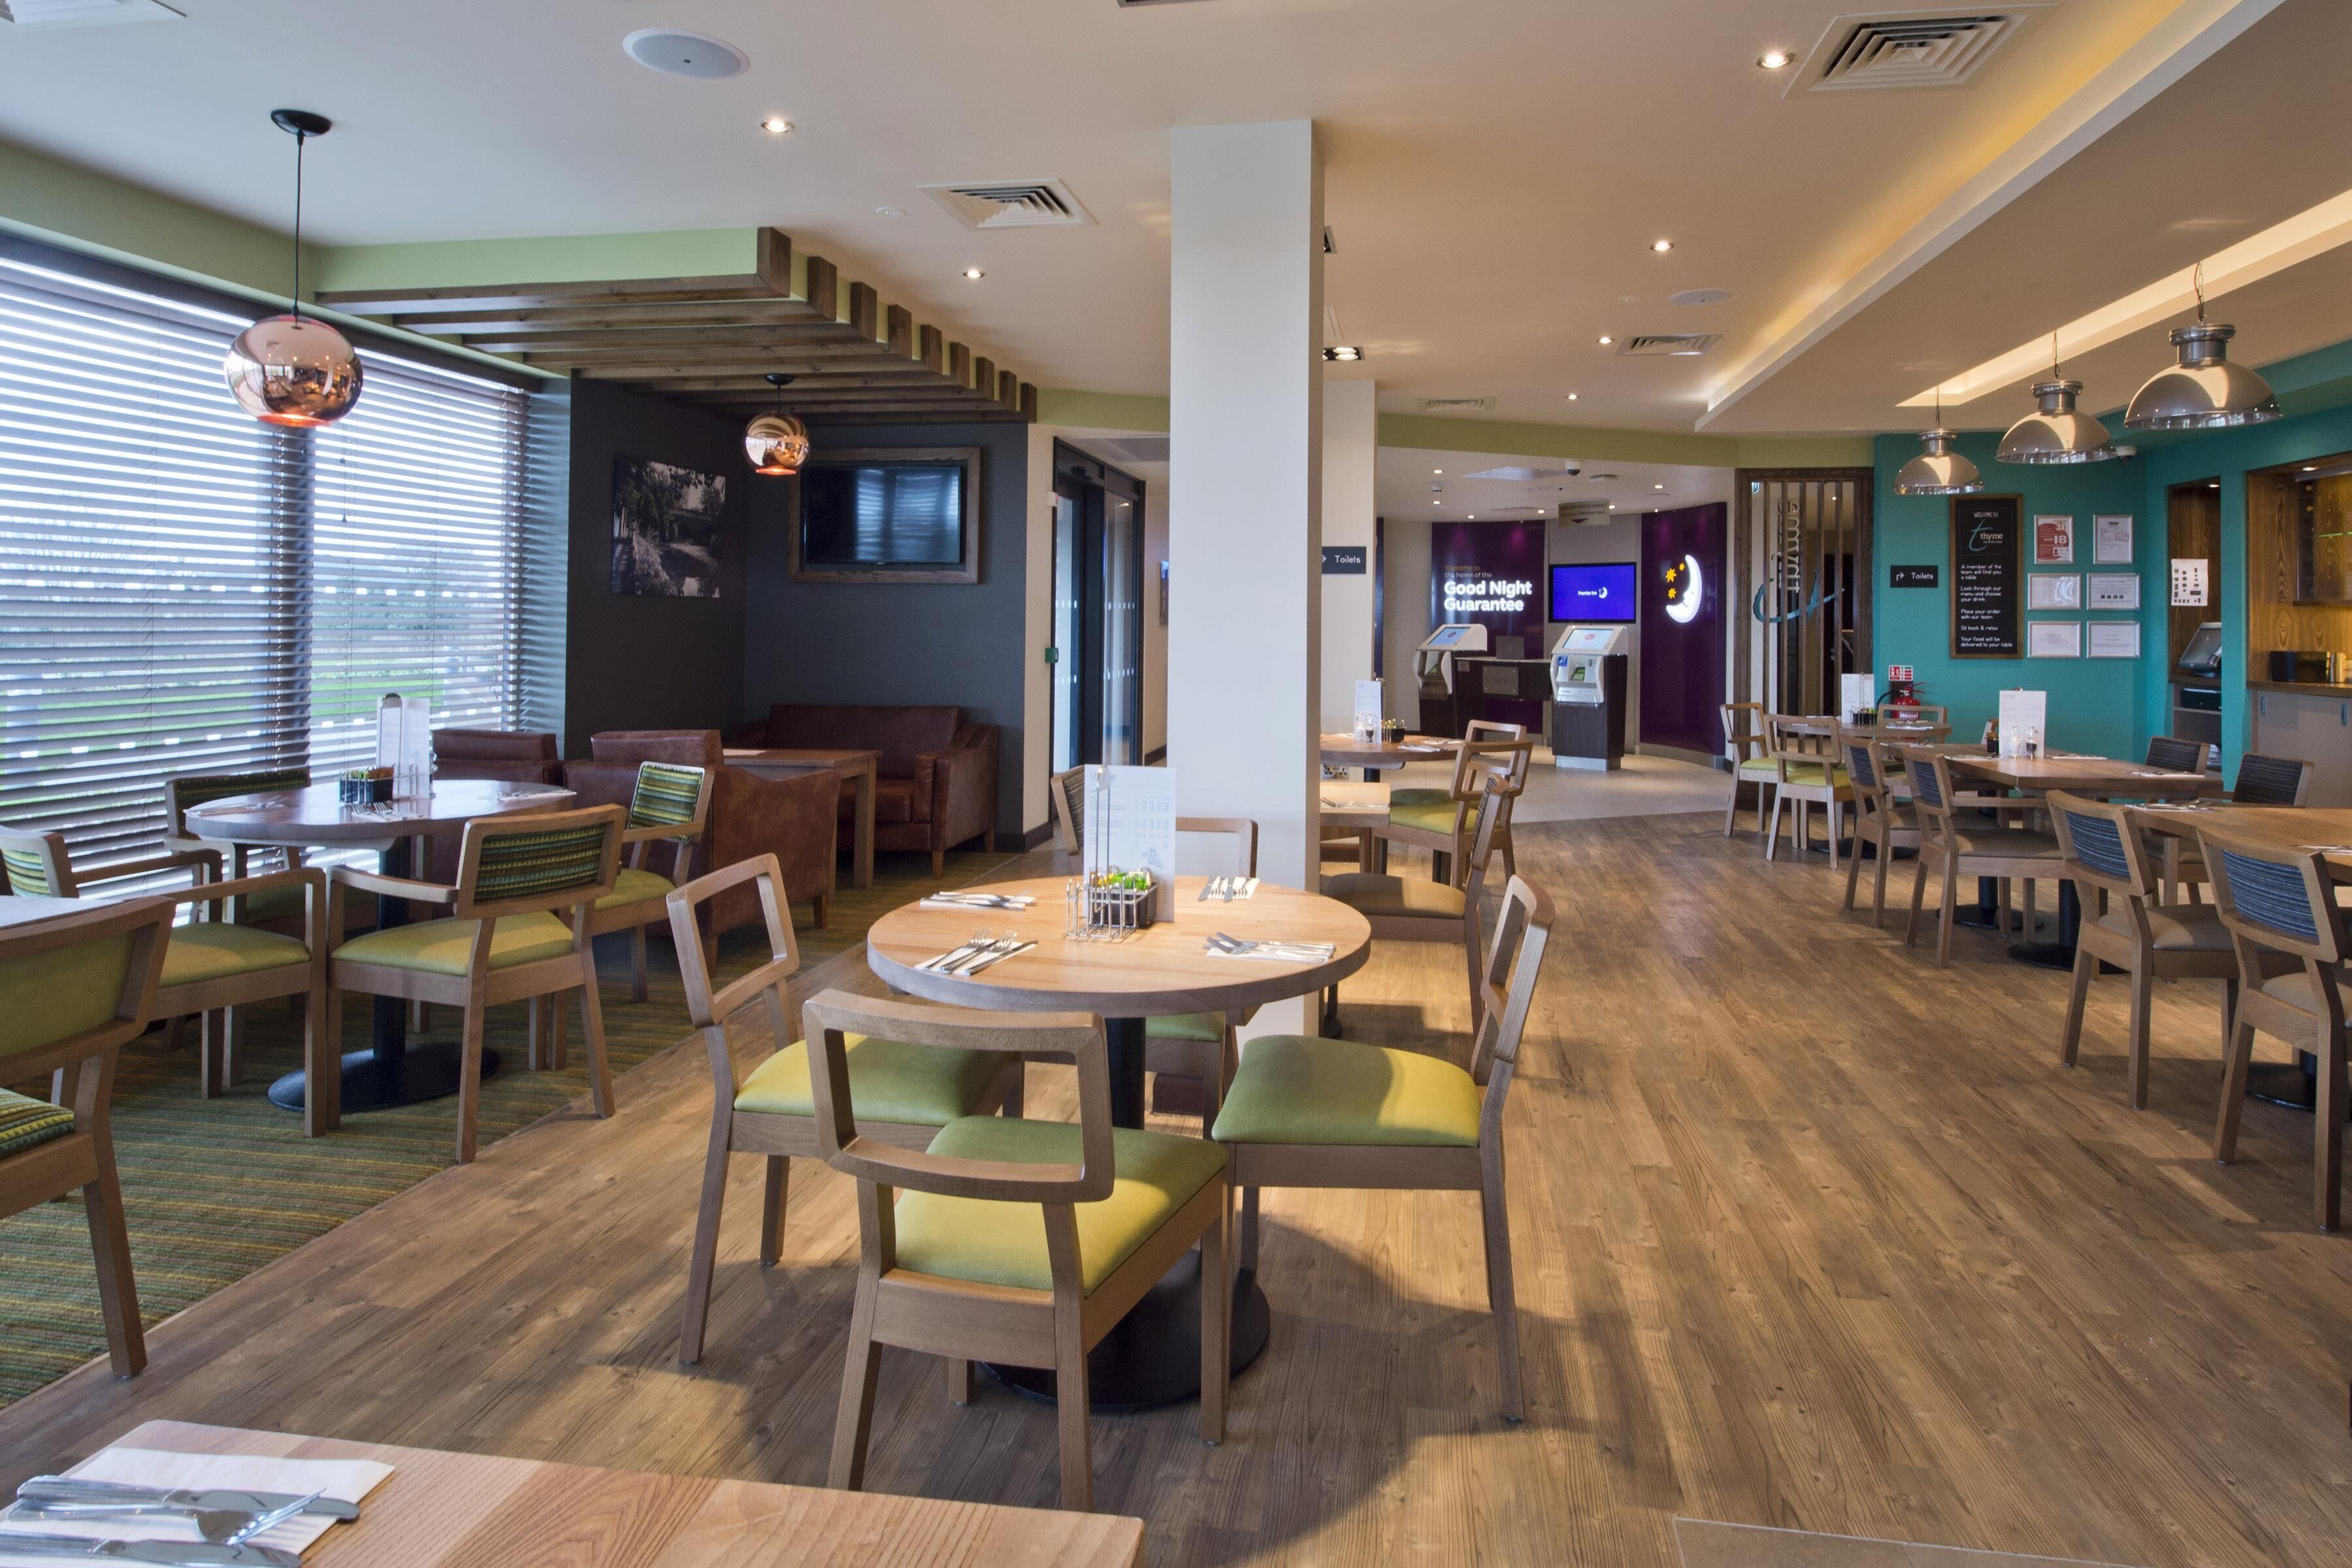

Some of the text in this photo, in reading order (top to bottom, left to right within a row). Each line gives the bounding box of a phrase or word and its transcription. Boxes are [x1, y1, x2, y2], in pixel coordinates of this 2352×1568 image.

[2054, 535, 2067, 544] 18
[1444, 580, 1532, 598] Good Night
[1444, 597, 1524, 612] Guarantee
